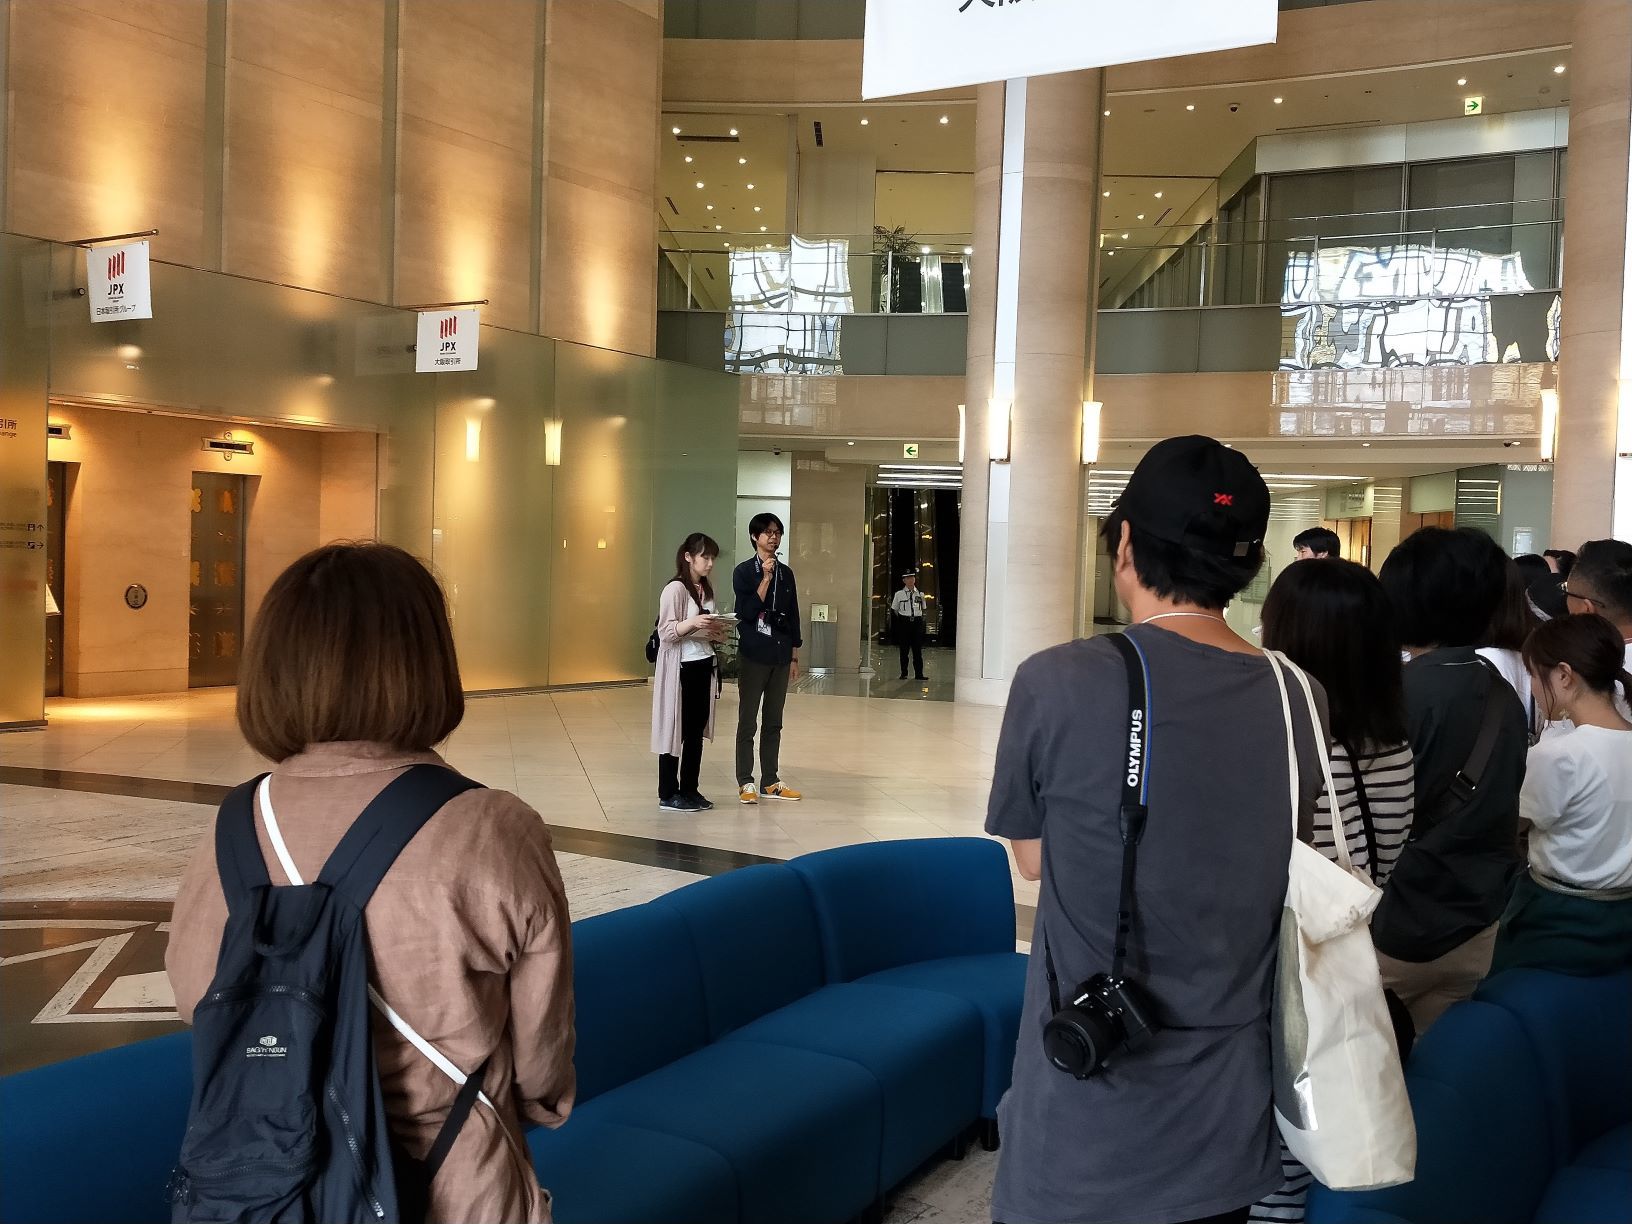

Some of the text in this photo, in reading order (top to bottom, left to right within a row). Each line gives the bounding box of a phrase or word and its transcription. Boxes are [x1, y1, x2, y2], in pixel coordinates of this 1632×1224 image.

[107, 283, 125, 295] JPX
[439, 341, 457, 351] JPX
[1126, 709, 1143, 787] OLYMPUS
